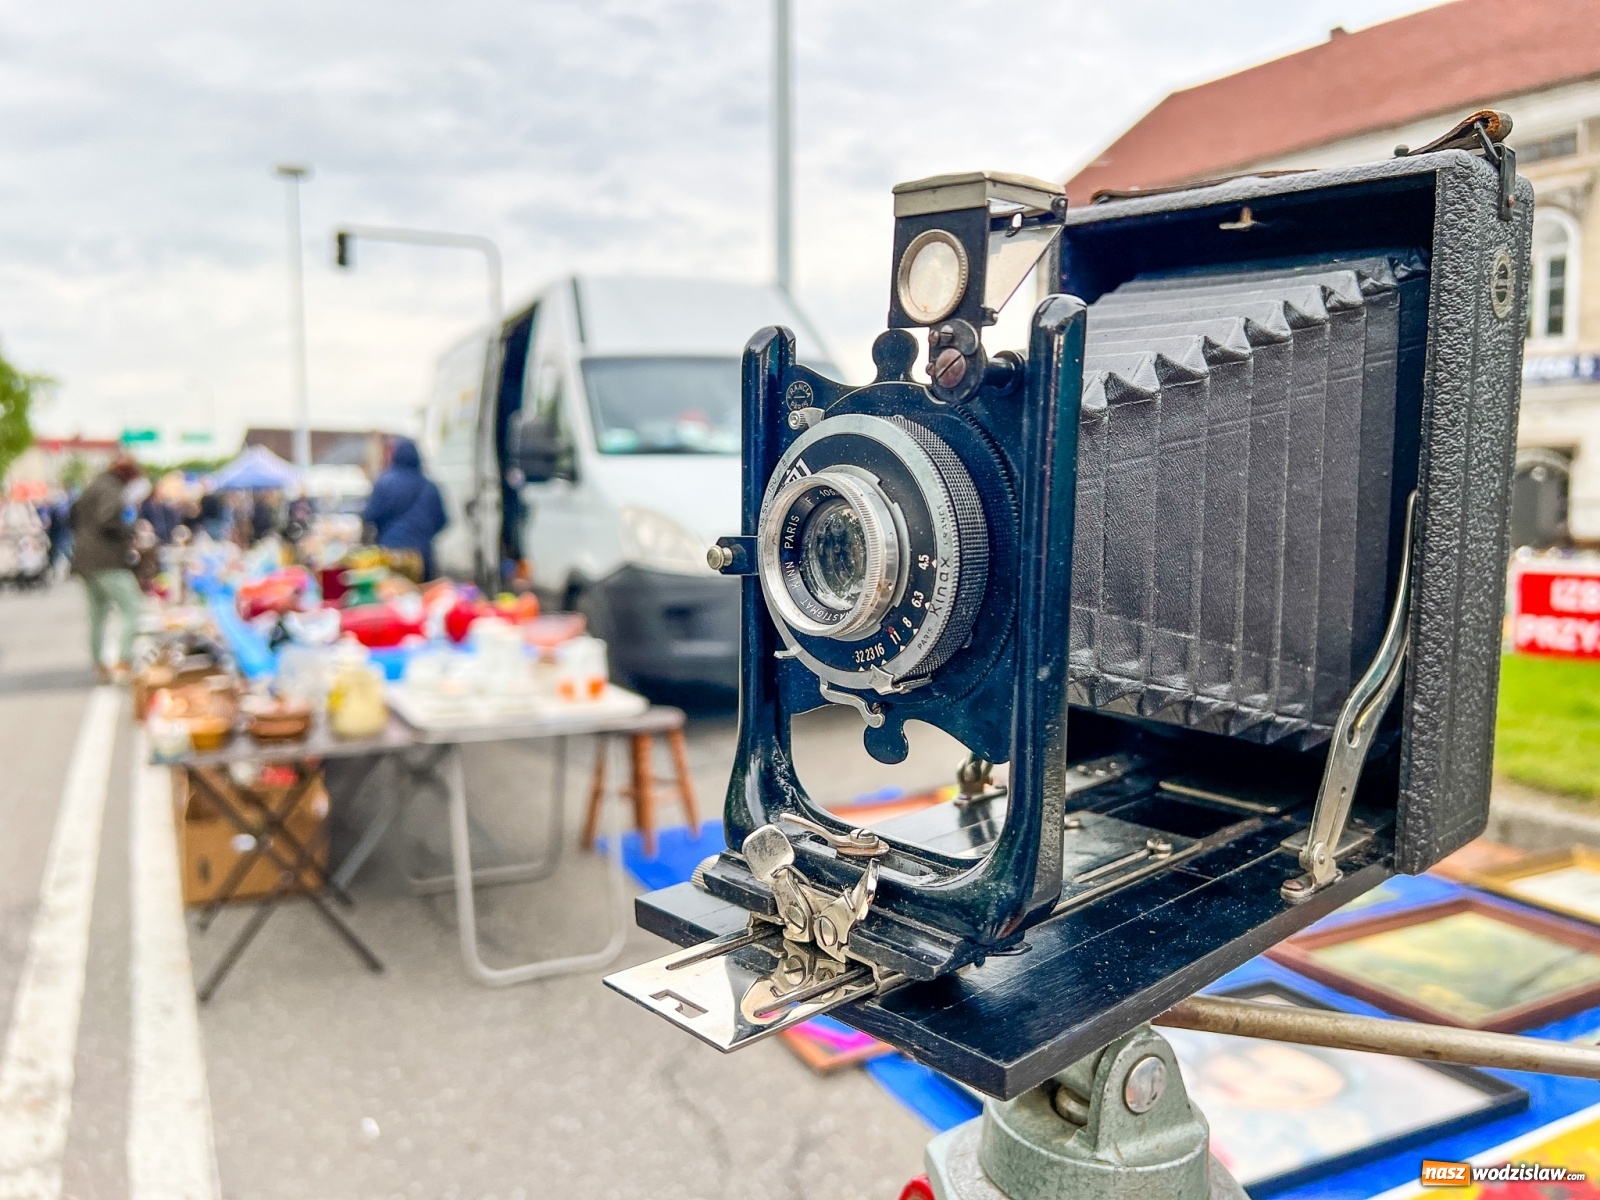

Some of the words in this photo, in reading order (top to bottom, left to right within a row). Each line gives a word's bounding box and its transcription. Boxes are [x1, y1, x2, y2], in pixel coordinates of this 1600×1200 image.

[784, 515, 800, 549] PARIS
[785, 561, 801, 590] KINN
[902, 616, 912, 628] 8
[889, 630, 901, 645] 11
[917, 627, 934, 650] PARIS
[874, 642, 885, 657] 16
